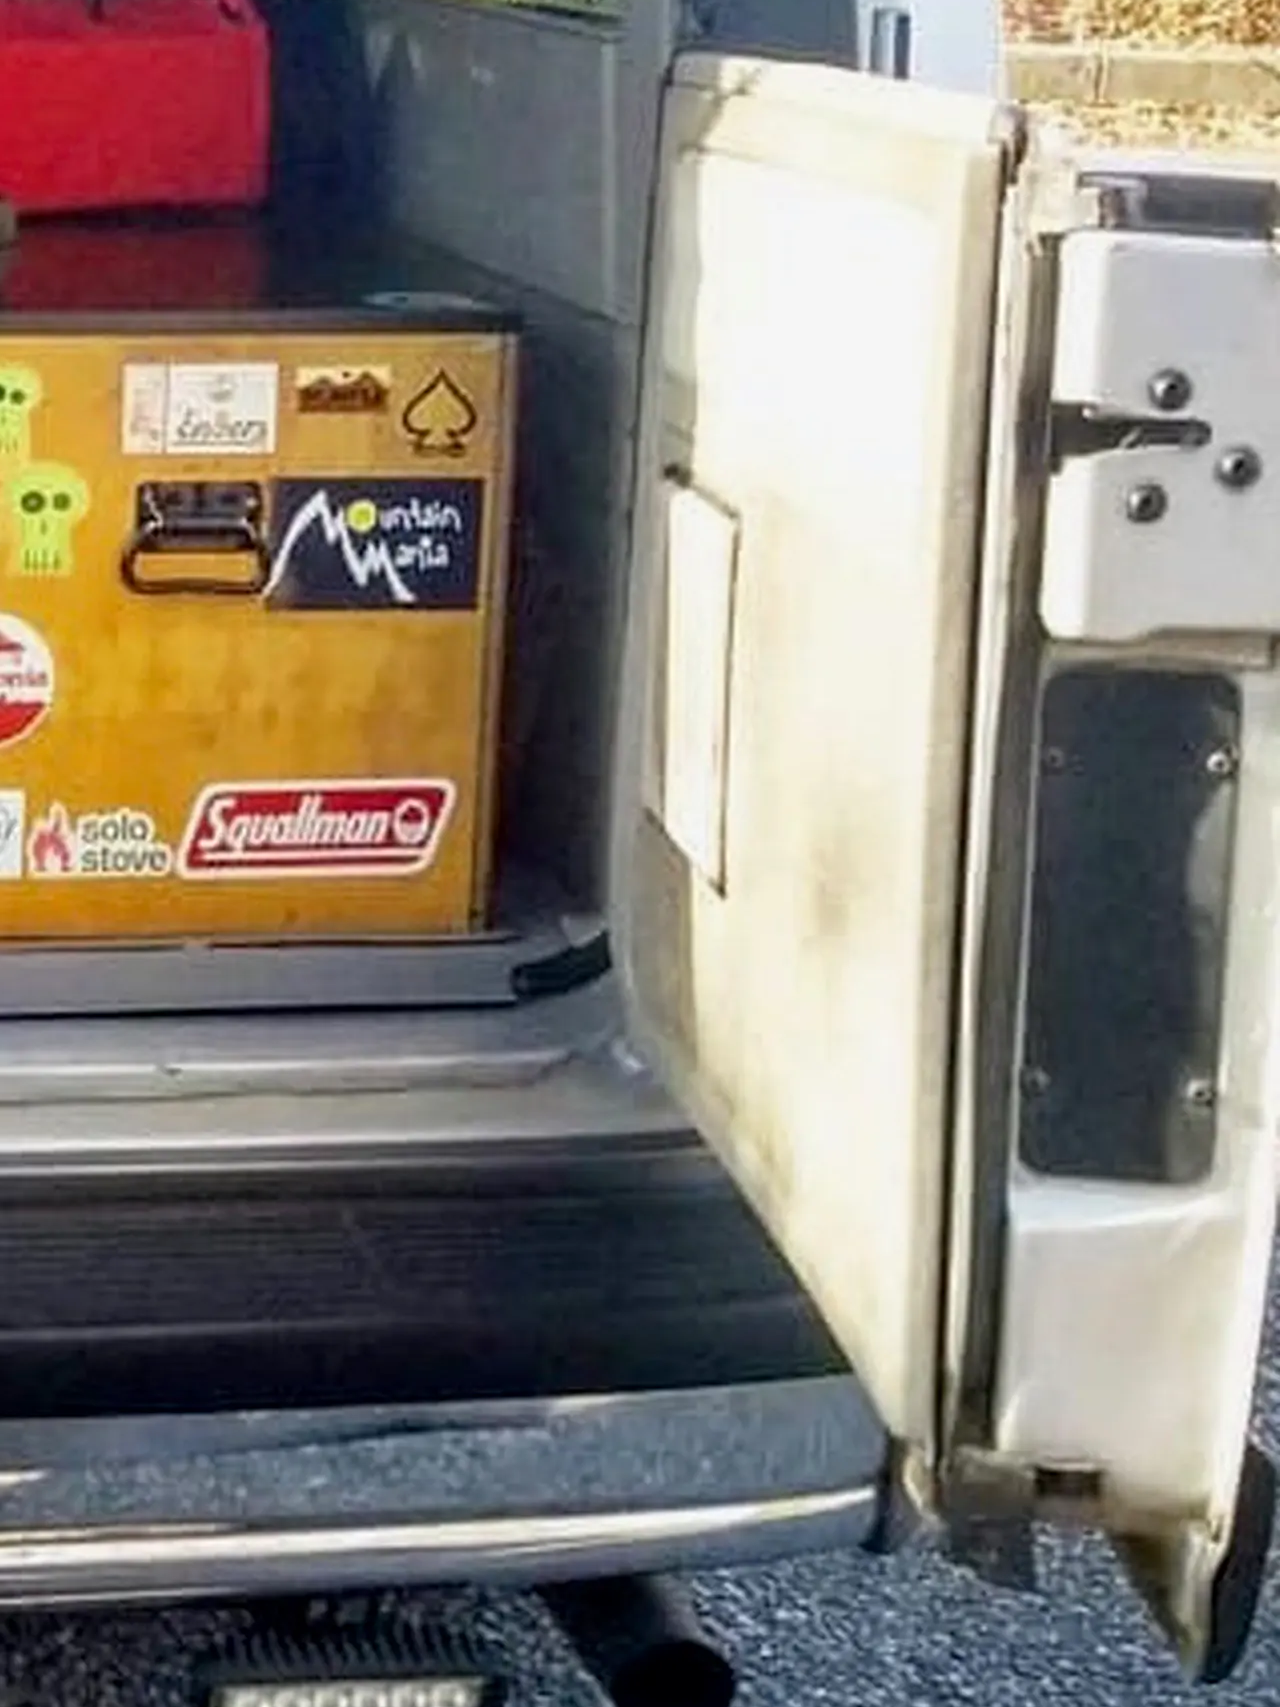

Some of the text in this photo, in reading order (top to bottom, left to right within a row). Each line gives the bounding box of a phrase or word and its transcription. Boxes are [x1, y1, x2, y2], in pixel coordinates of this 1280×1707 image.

[262, 490, 463, 598] Mountain
[81, 815, 148, 842] solo
[198, 794, 390, 851] Squallman
[81, 847, 167, 872] stove
